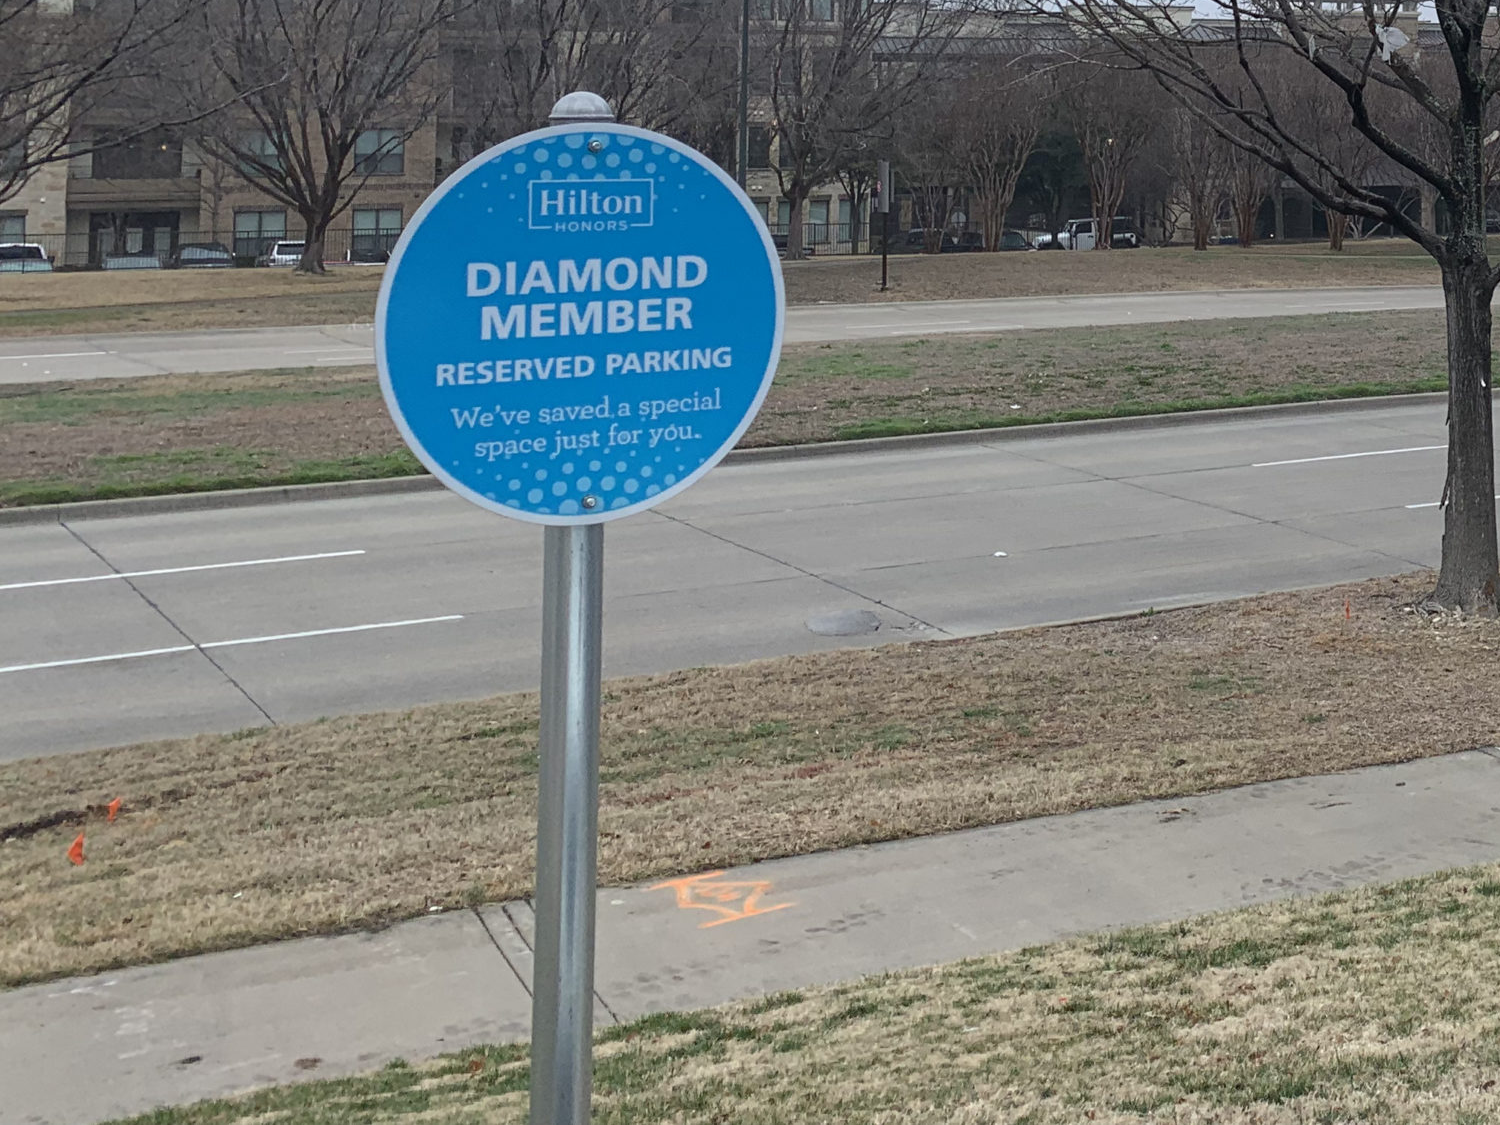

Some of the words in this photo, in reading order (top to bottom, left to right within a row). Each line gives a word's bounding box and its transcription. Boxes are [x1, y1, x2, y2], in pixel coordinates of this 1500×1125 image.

[539, 188, 643, 217] Hilton
[554, 220, 628, 233] HONORS
[466, 254, 708, 297] DIAMOND
[480, 297, 693, 341] MEMBER
[435, 355, 596, 387] RESERVED
[605, 346, 732, 376] PARKING
[451, 404, 531, 430] We've
[538, 395, 610, 424] saved
[617, 402, 631, 418] a
[638, 387, 722, 421] special
[474, 437, 547, 462] space
[550, 429, 601, 457] just
[607, 422, 643, 446] for
[649, 423, 703, 452] you.
